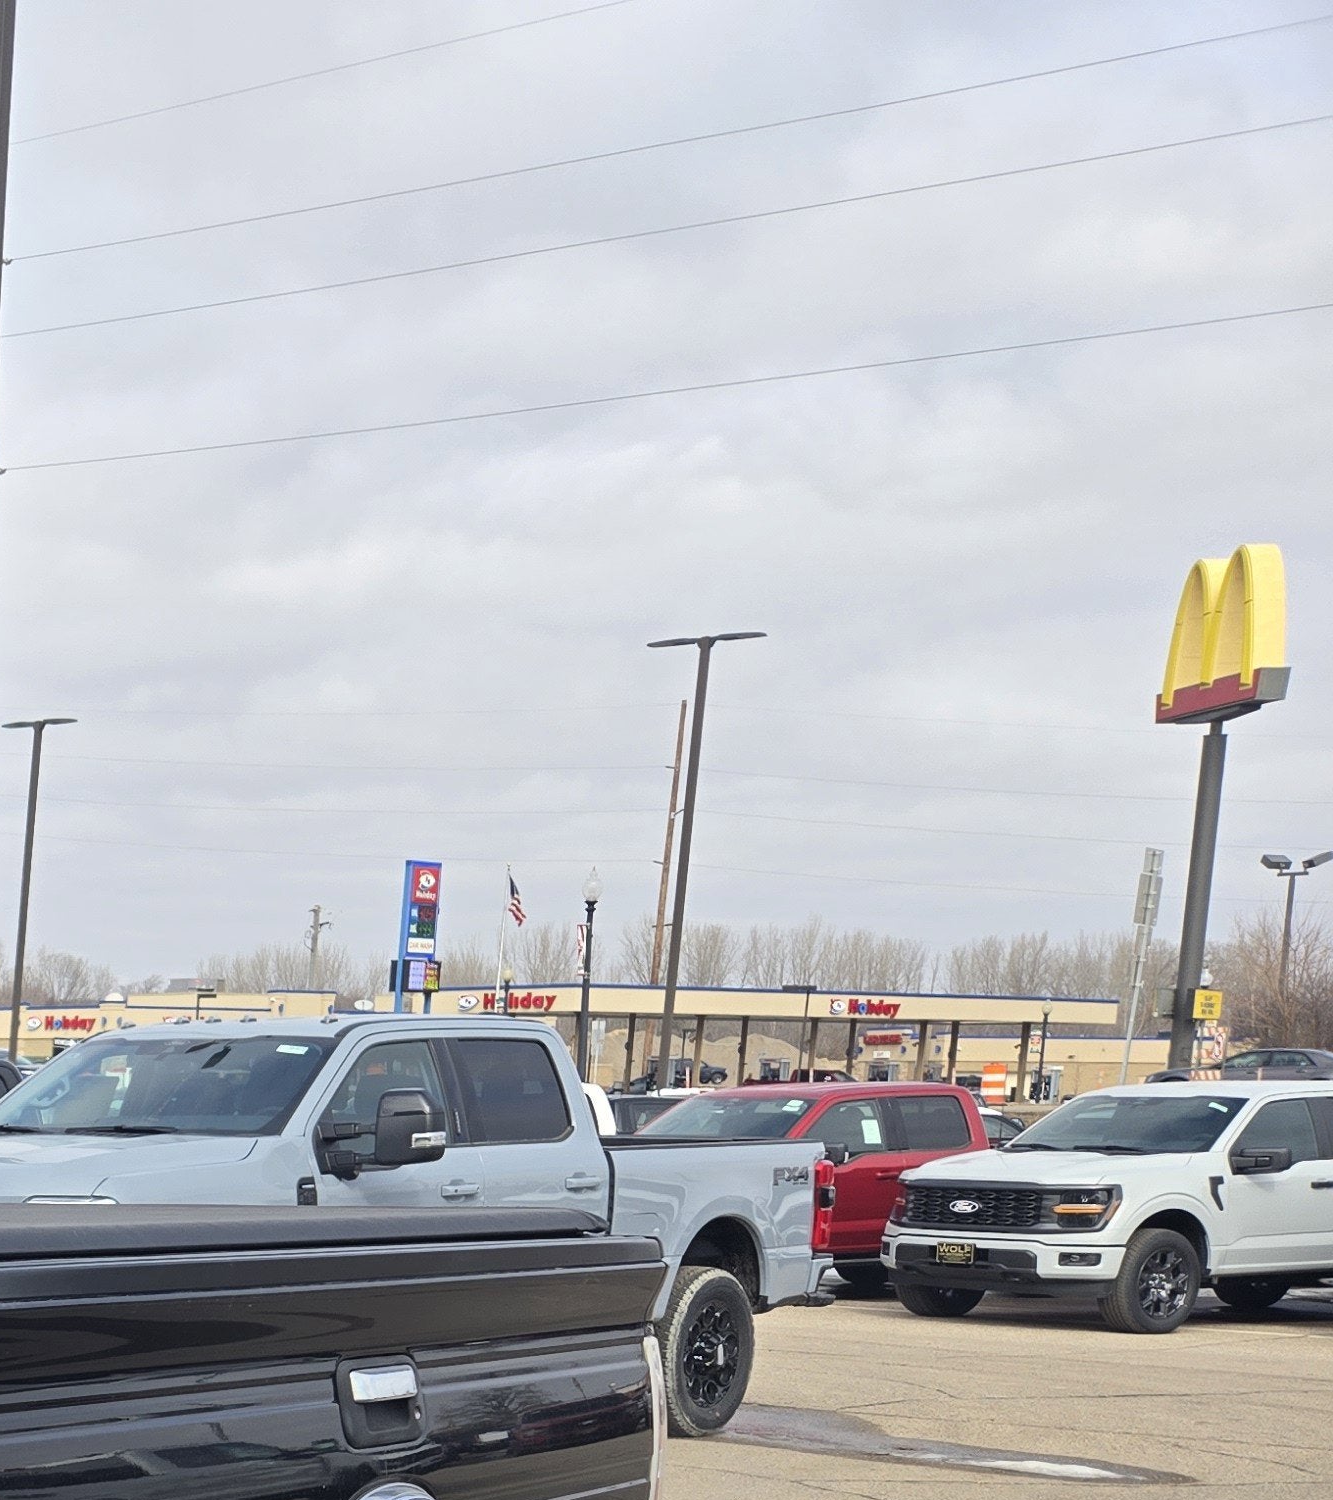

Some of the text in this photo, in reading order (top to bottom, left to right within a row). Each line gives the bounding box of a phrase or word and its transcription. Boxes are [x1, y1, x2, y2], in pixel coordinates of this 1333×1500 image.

[415, 890, 436, 900] Holiday
[847, 998, 901, 1019] Holiday
[45, 1015, 96, 1032] Holiday
[773, 1166, 809, 1186] FX4
[939, 1243, 971, 1253] WOLF
